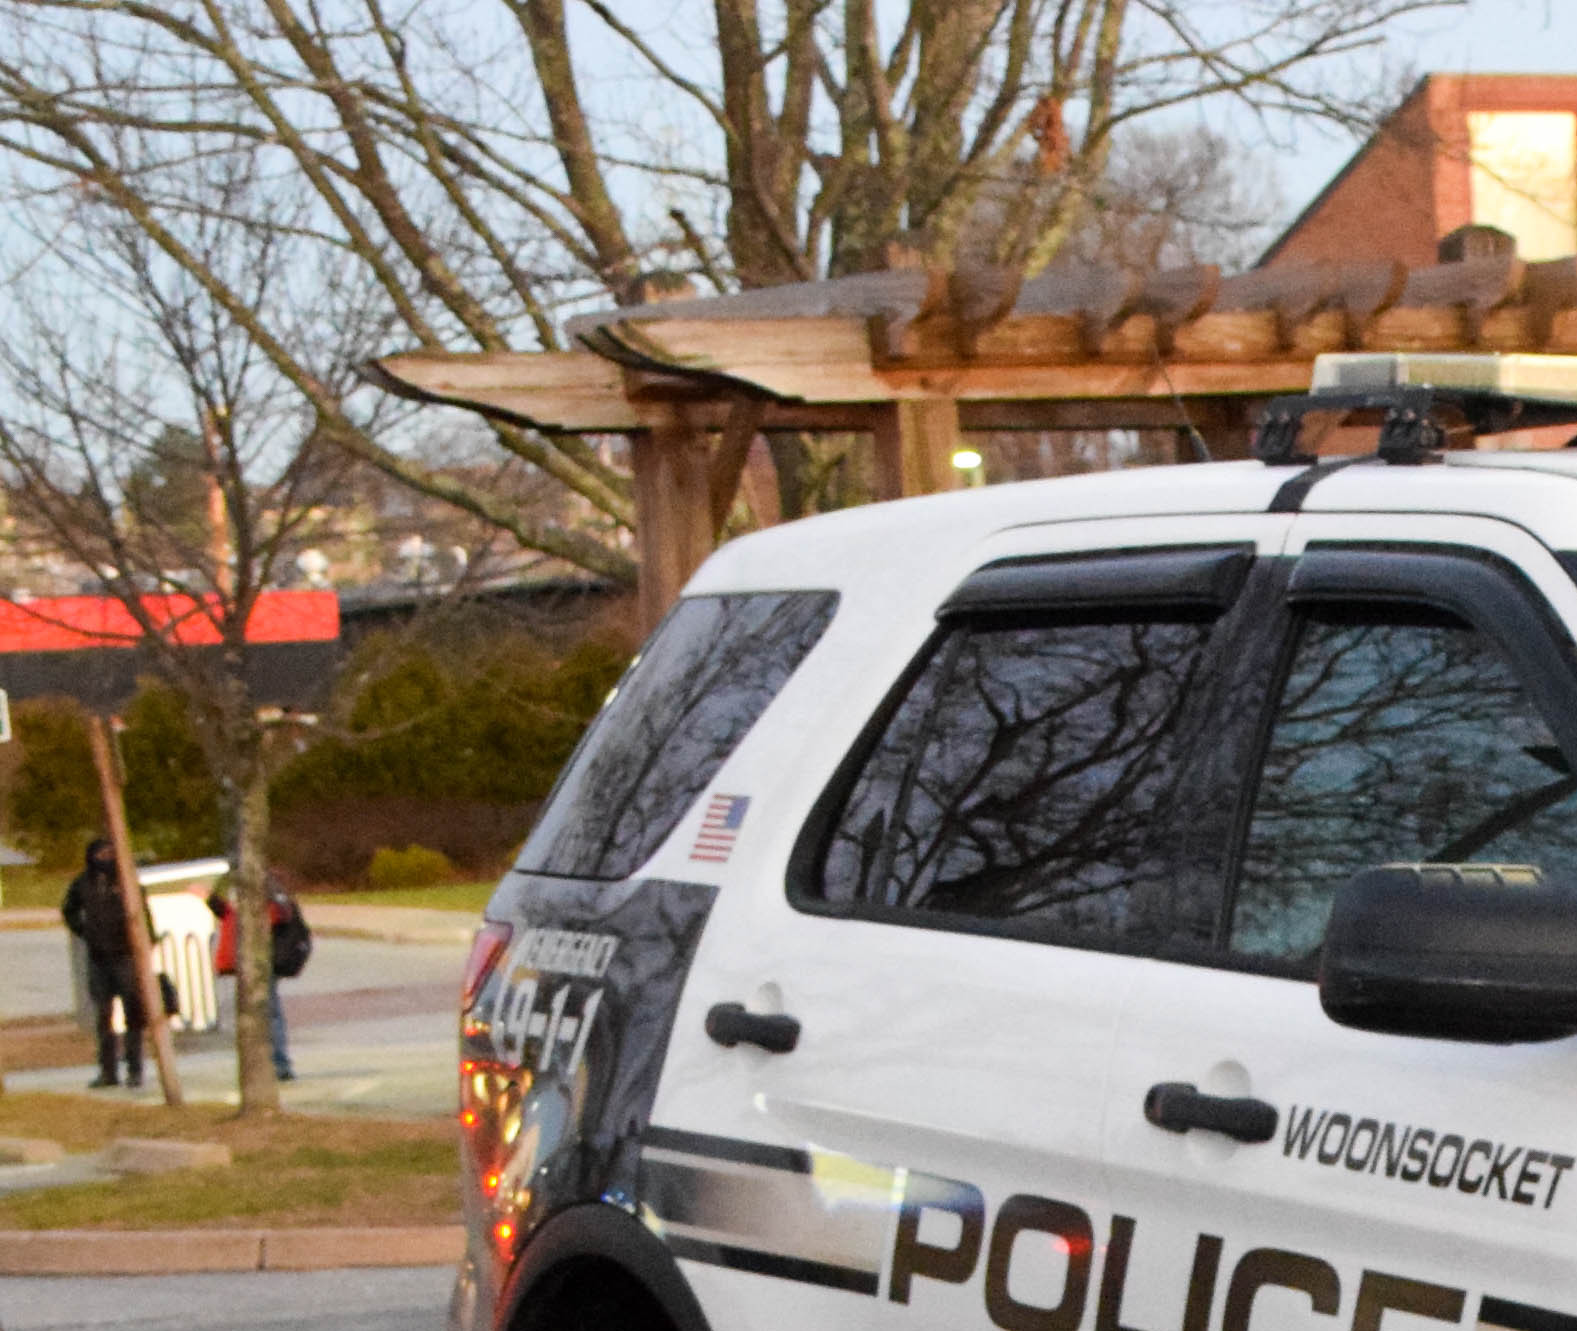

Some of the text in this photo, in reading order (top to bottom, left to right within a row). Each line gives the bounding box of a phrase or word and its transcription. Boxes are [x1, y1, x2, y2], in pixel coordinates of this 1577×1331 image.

[526, 929, 622, 979] EMERGENCY
[503, 977, 606, 1075] 9-1-1
[1281, 1104, 1577, 1211] WOONSOCKET
